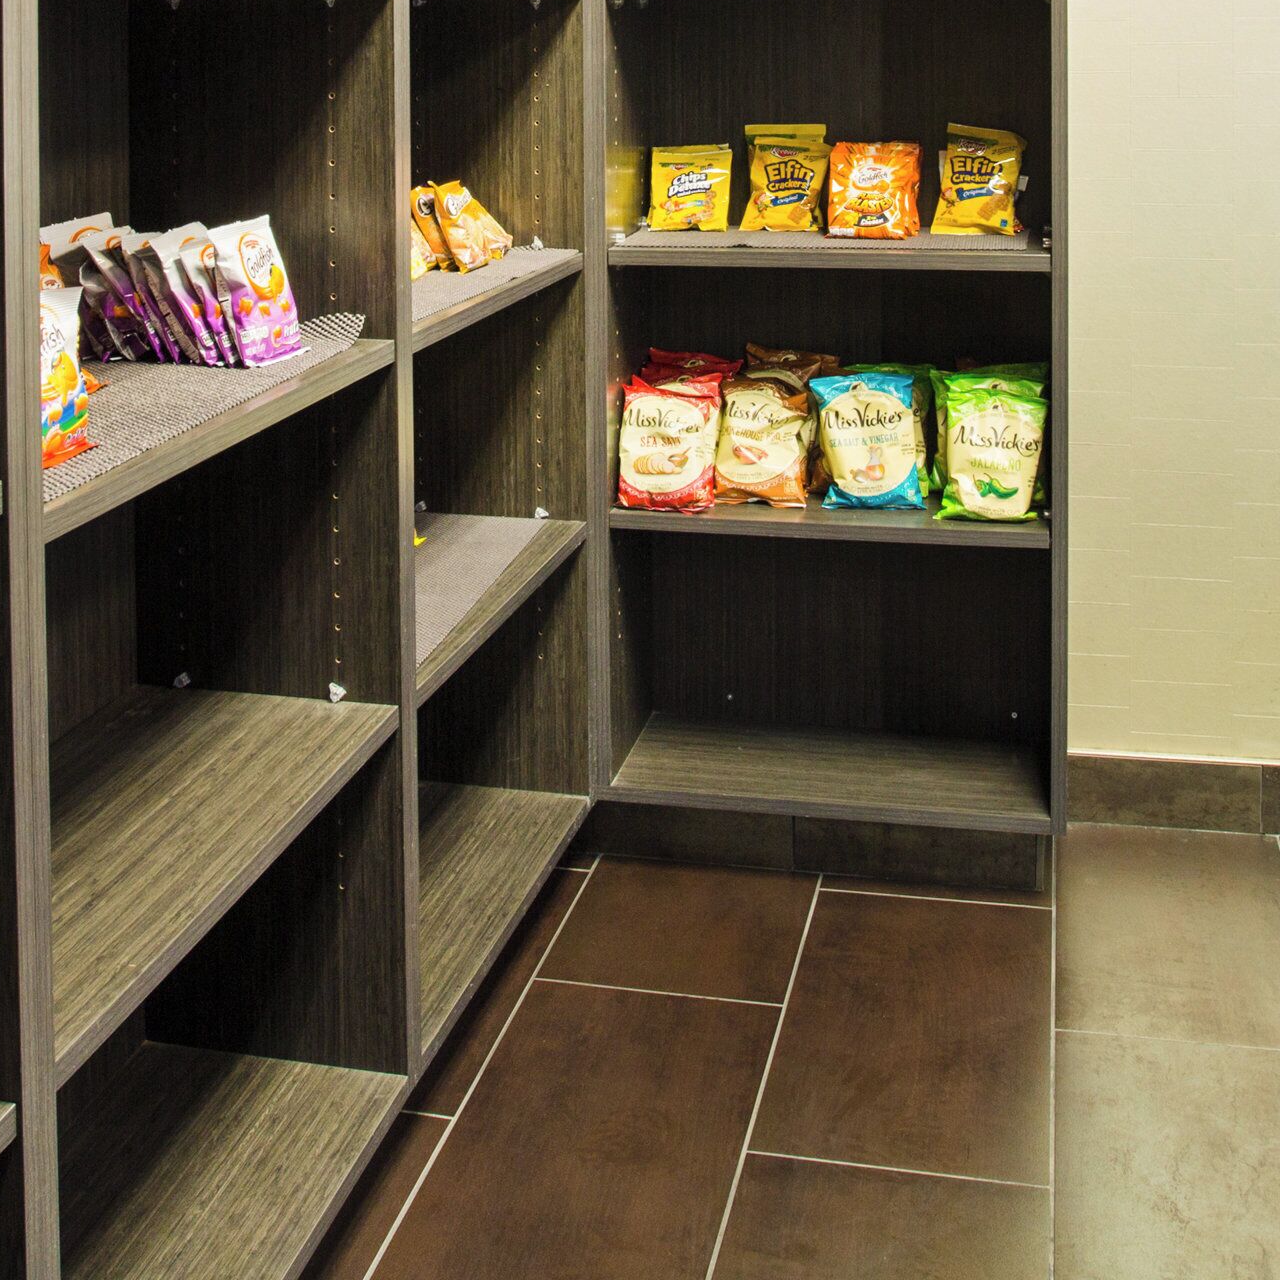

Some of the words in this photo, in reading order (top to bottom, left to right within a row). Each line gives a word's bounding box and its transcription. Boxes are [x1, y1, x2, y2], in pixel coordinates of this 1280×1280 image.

[765, 160, 813, 182] Elfin
[953, 157, 1001, 174] Elfin
[672, 171, 706, 185] Chips
[767, 179, 810, 192] Crackers
[951, 173, 993, 183] Cracker
[624, 407, 657, 428] Miss
[823, 410, 858, 431] Miss
[854, 402, 903, 430] Vickie's
[640, 435, 658, 447] SEA
[829, 438, 842, 449] SEA
[869, 432, 899, 445] VINEGAR
[953, 425, 992, 448] Miss
[991, 425, 1041, 457] Vickie's
